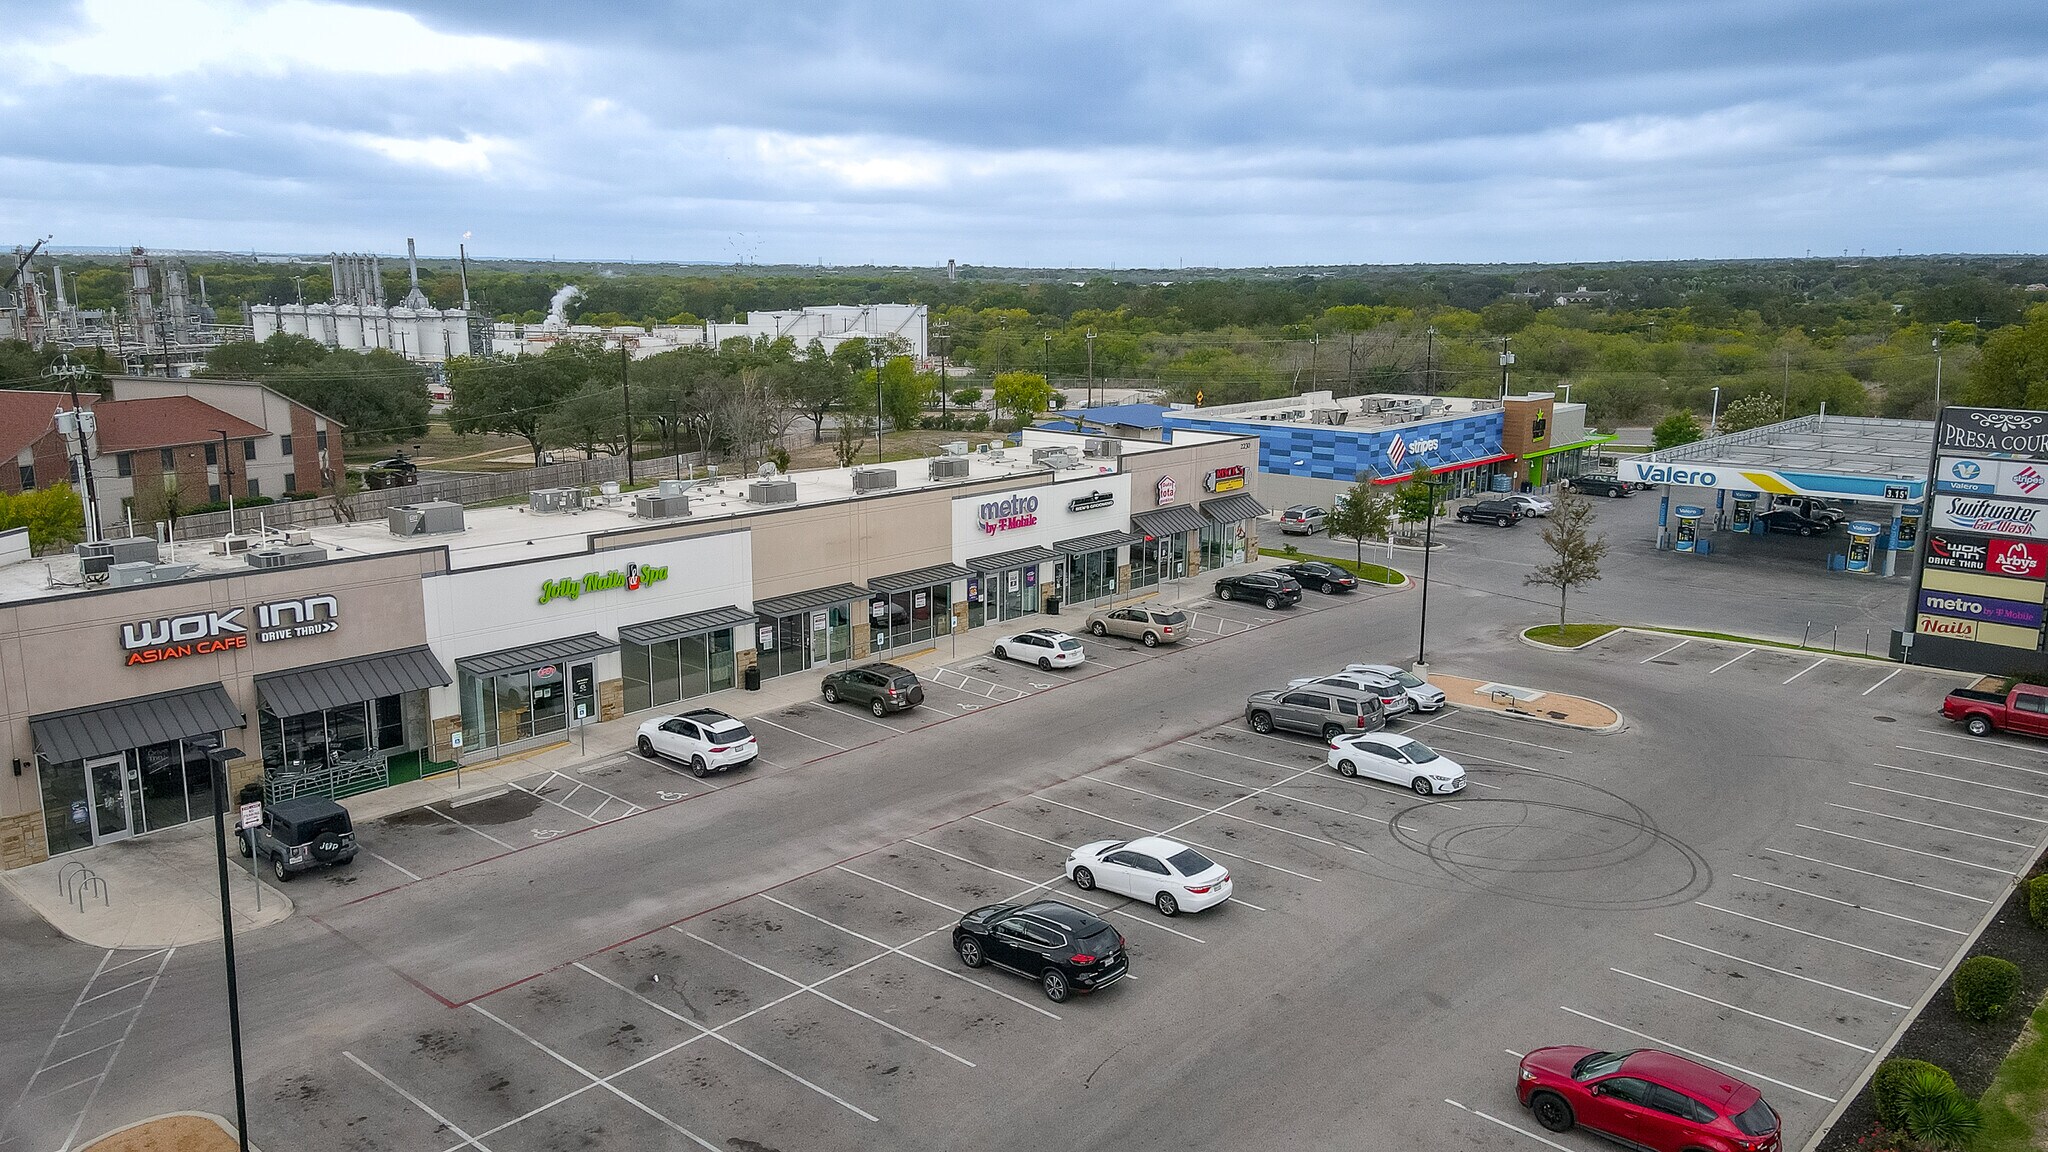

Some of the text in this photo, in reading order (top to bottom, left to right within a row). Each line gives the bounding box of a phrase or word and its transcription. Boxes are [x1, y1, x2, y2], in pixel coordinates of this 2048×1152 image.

[1944, 424, 1997, 449] PRESA
[1408, 438, 1439, 455] stripes
[1636, 464, 1717, 486] Valero
[2012, 475, 2045, 485] stripes
[1950, 482, 1979, 490] Valero
[980, 494, 1039, 520] metro
[1946, 497, 2041, 522] Swiftwater
[985, 522, 997, 536] by
[1972, 518, 2032, 535] Car Wash
[1947, 544, 1987, 554] WOK
[1928, 556, 1984, 569] DRIVE THRU
[1995, 553, 2037, 569] Arby's
[539, 579, 581, 604] Jolly
[583, 571, 625, 593] Nails
[640, 564, 669, 588] Spa
[1926, 596, 1983, 614] metro
[1983, 607, 1994, 616] by
[123, 607, 248, 650] WOK
[261, 623, 322, 643] DRIVE THRU
[1921, 619, 1972, 635] Nails
[127, 636, 248, 666] ASIAN CAFE
